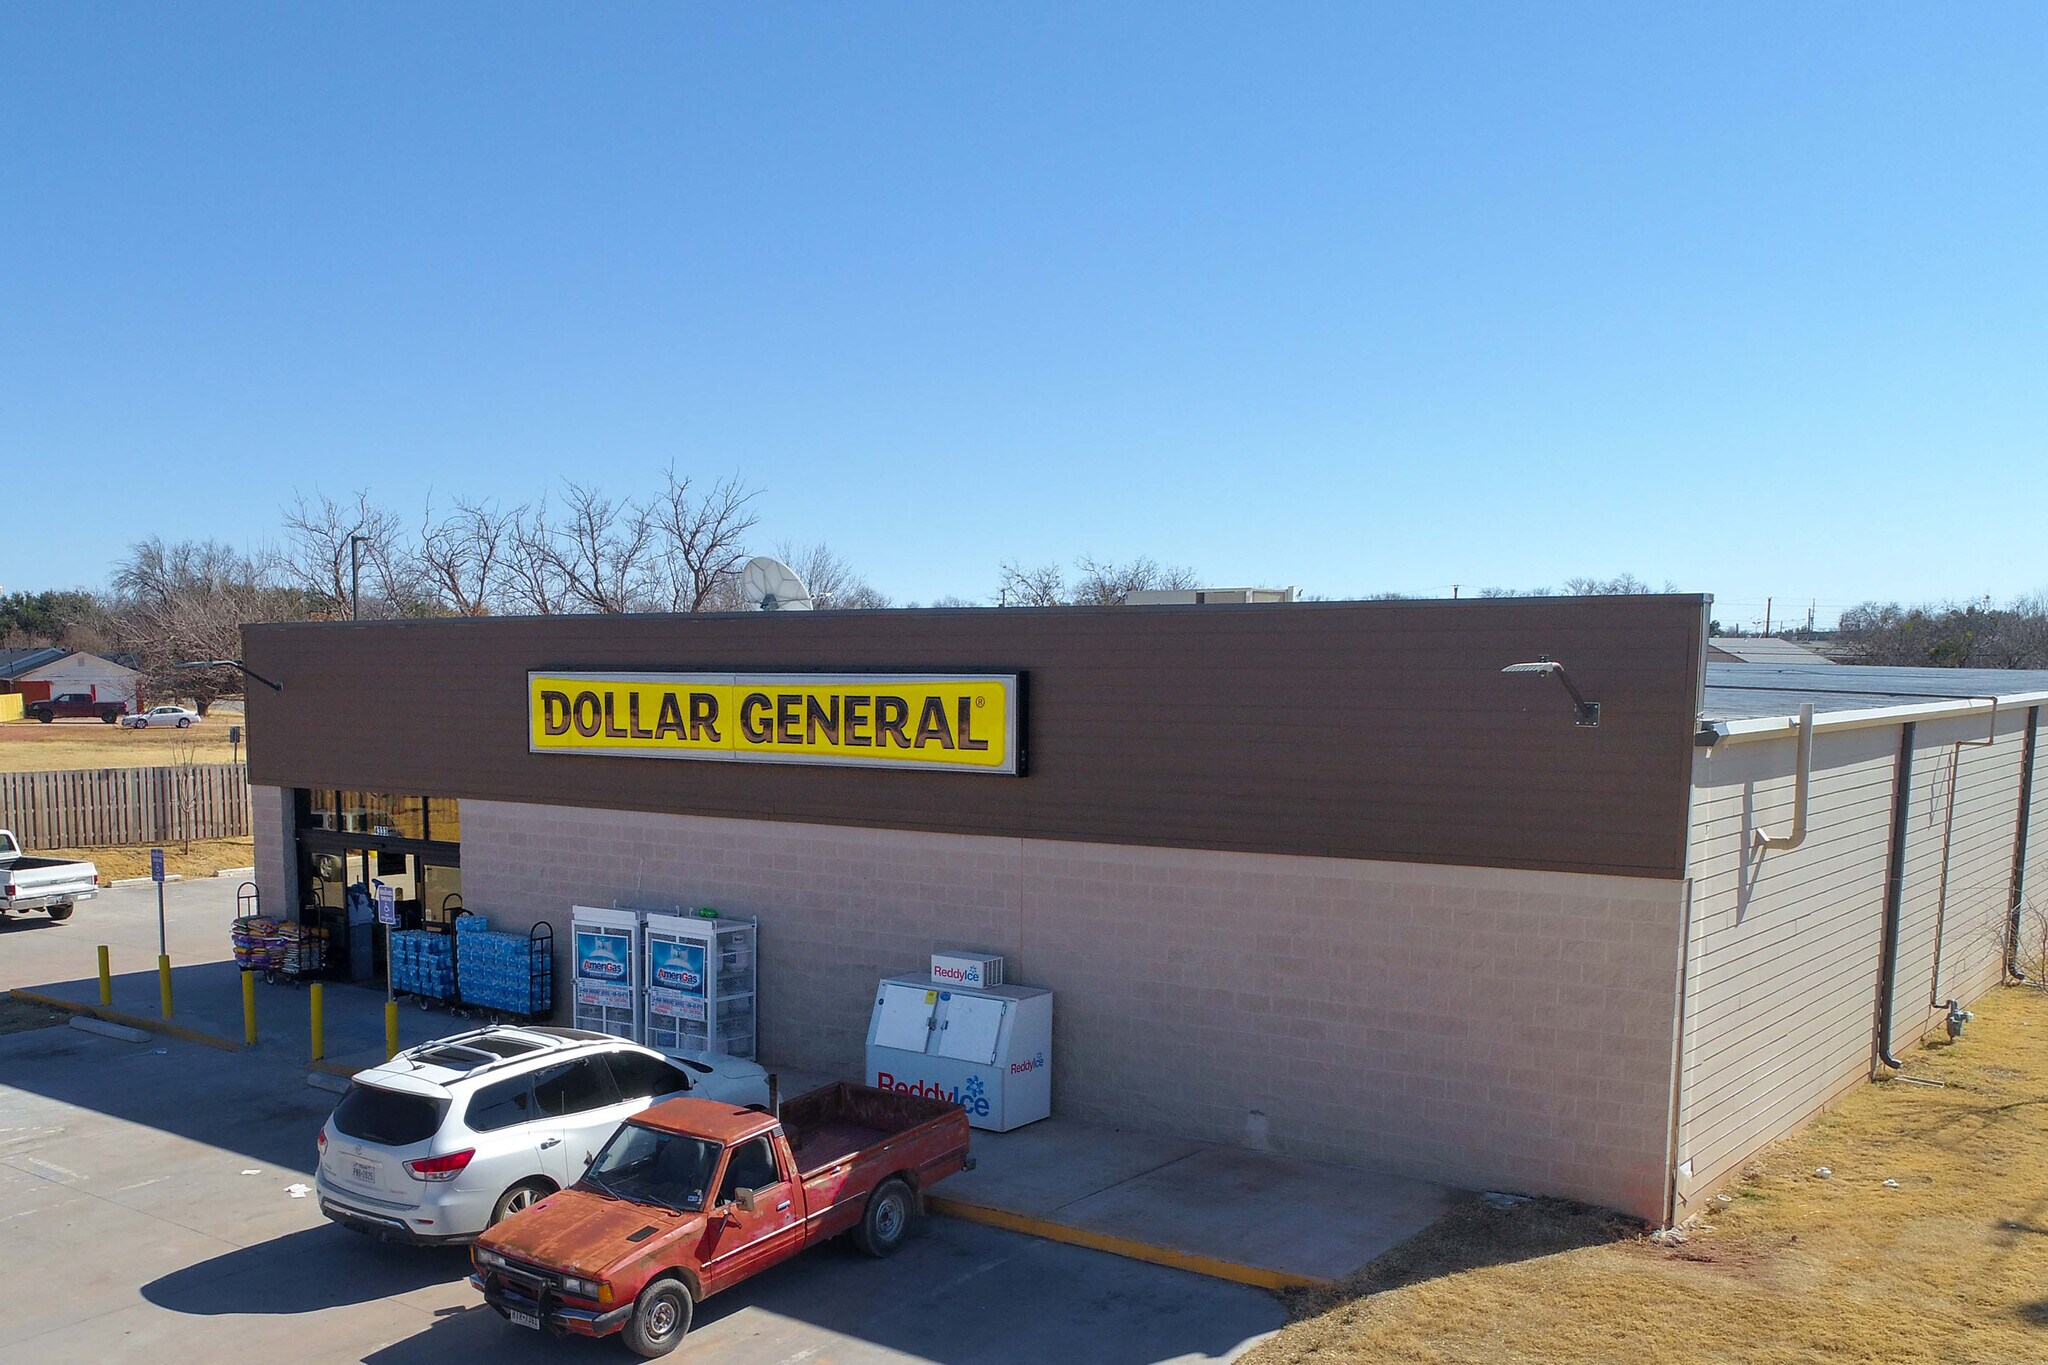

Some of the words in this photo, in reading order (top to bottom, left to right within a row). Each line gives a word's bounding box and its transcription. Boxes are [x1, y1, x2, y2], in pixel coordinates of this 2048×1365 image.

[541, 690, 721, 741] DOLLAR
[740, 693, 989, 751] GENERAL
[584, 960, 622, 973] AmeriGas
[658, 969, 698, 984] AmeriGas
